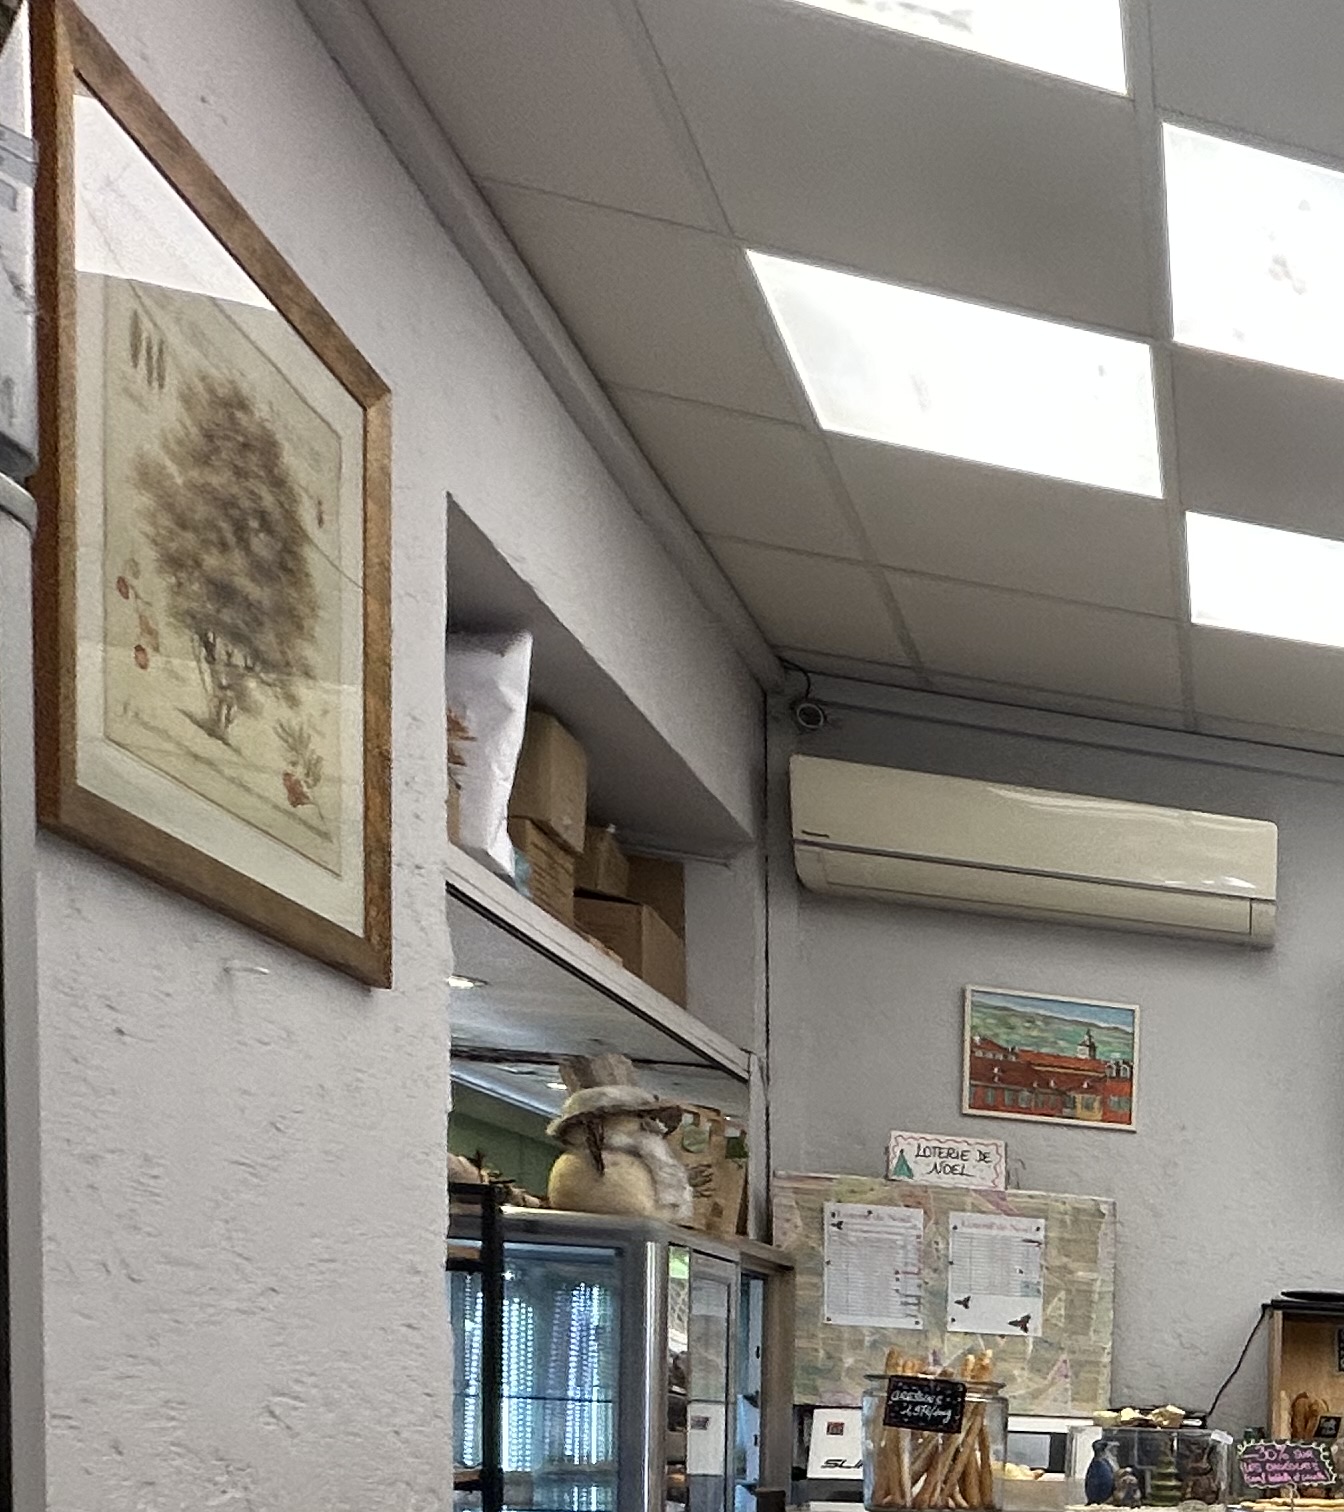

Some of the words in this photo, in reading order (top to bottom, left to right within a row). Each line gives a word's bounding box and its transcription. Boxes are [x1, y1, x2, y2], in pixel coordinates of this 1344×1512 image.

[915, 1143, 971, 1162] LOTERIE
[975, 1149, 993, 1164] DE
[926, 1160, 975, 1178] NOEL
